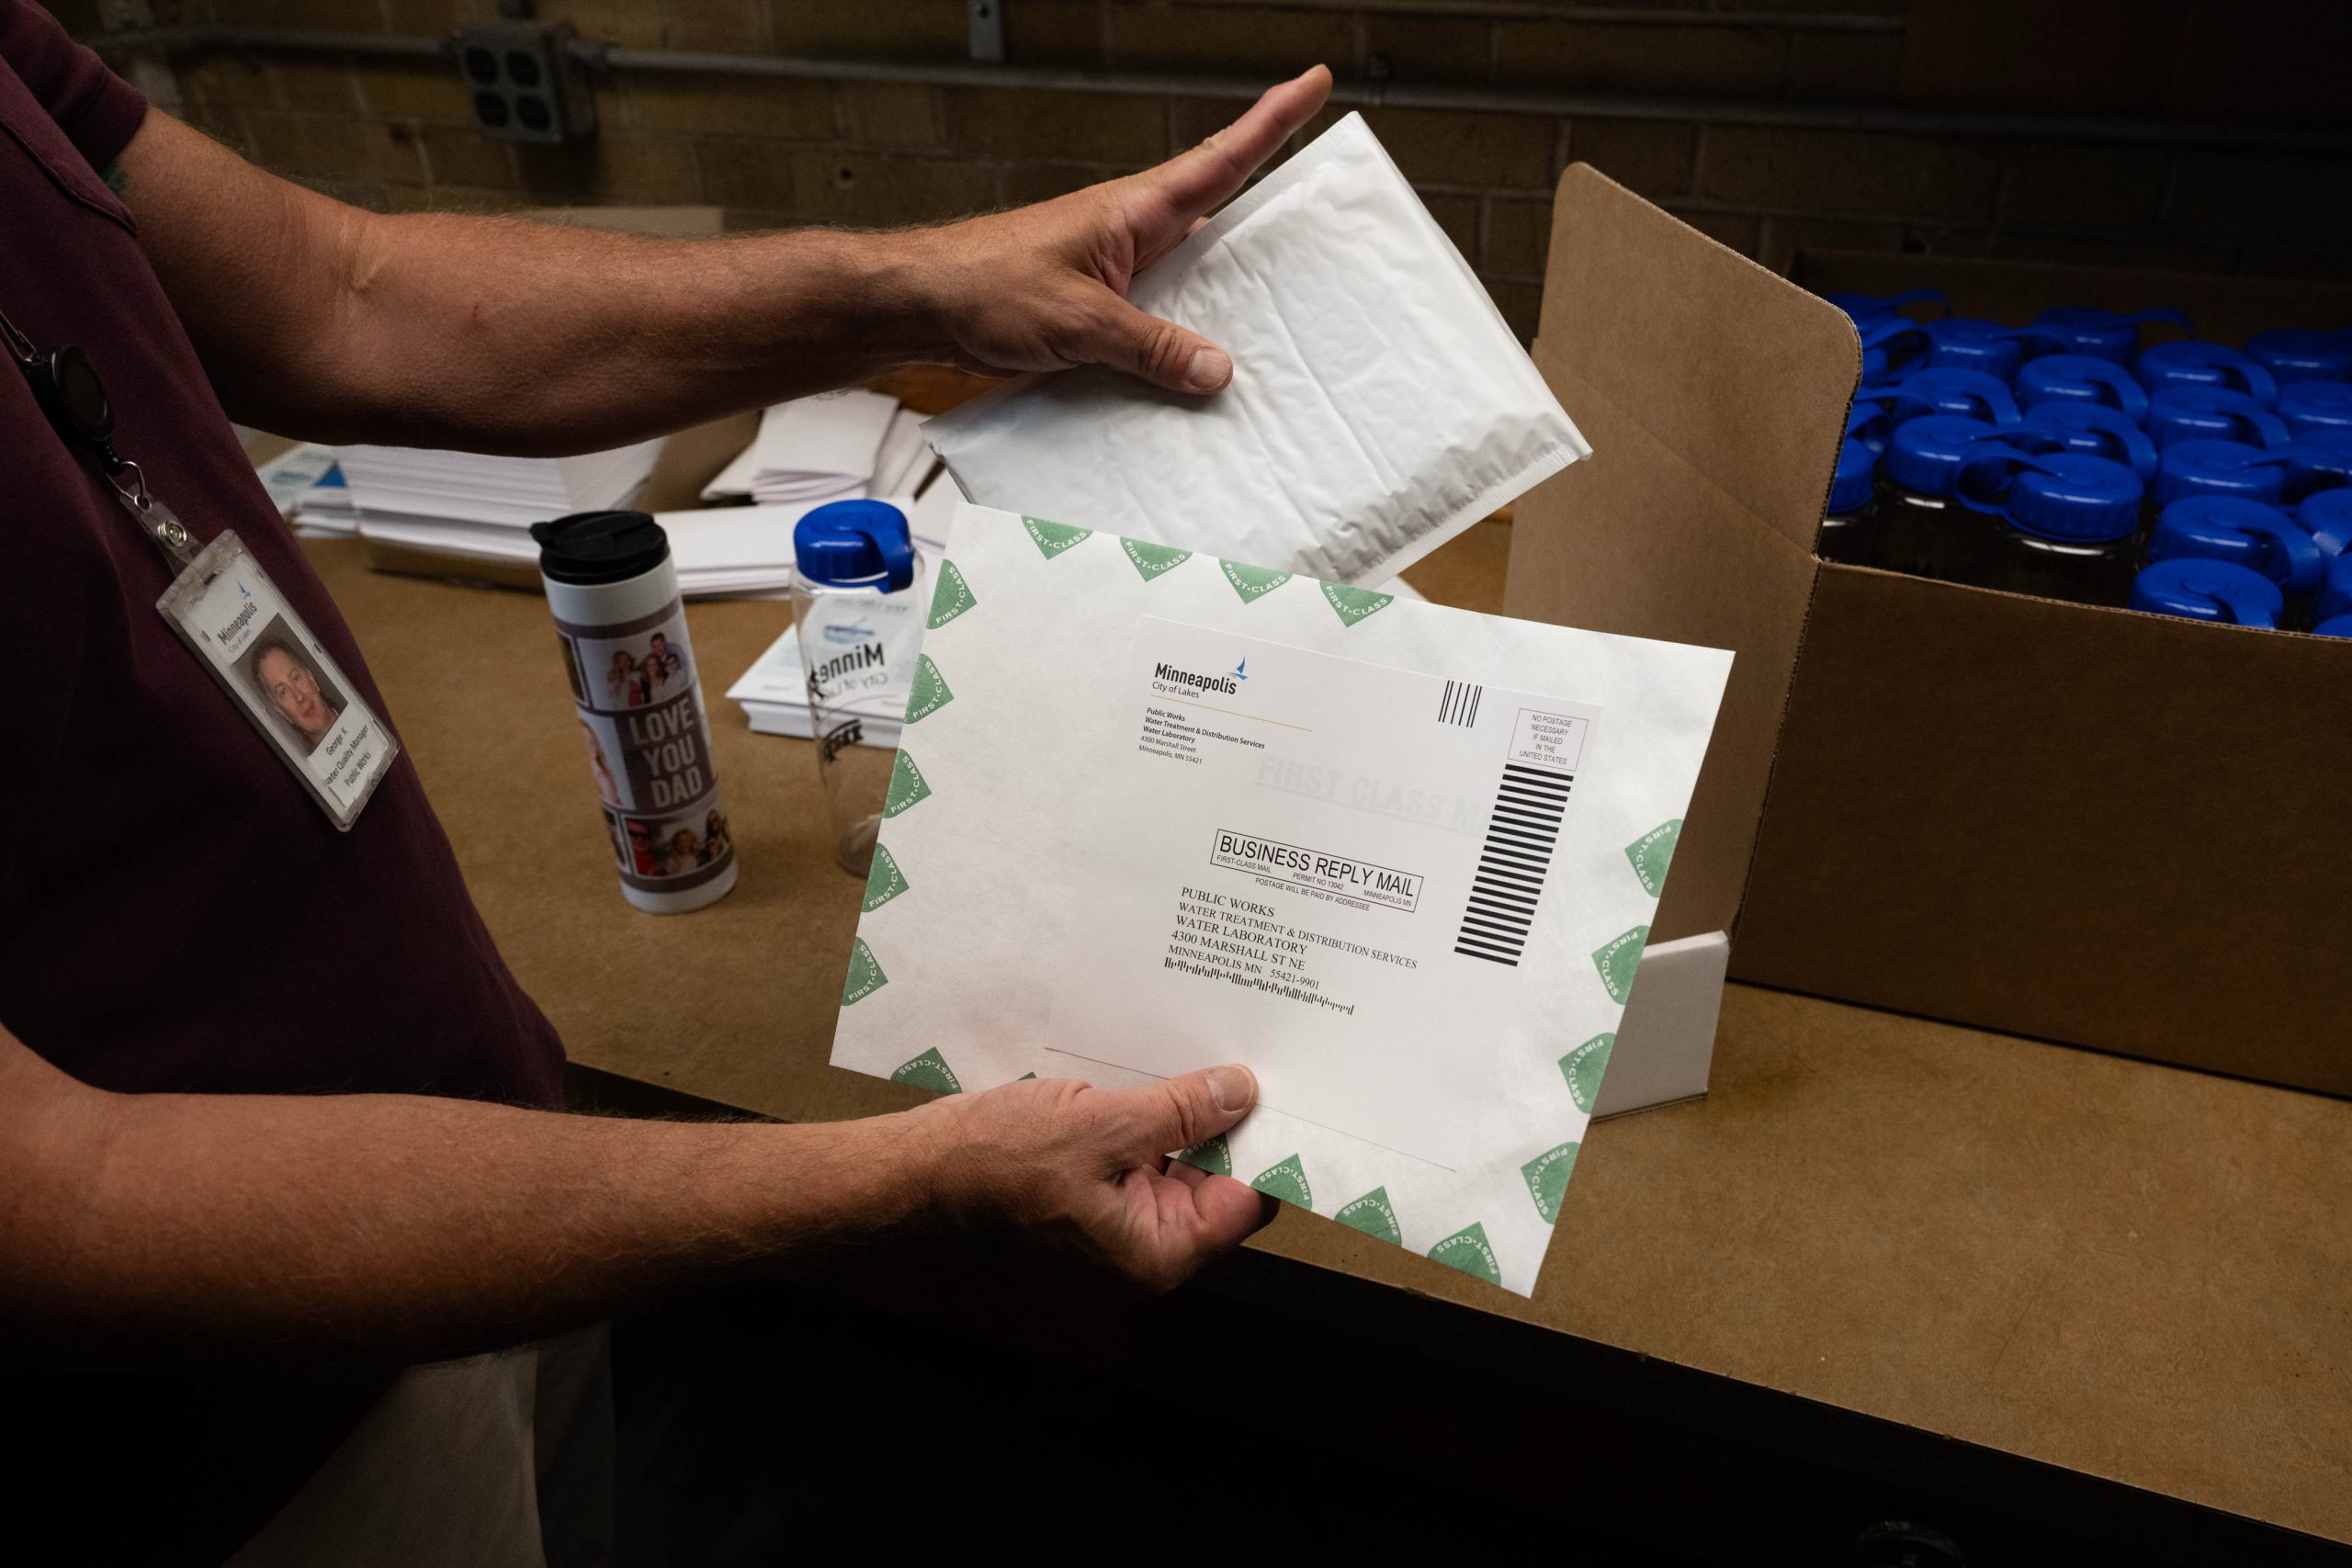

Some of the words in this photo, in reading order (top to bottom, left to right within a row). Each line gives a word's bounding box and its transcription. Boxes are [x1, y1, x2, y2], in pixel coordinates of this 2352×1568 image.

[218, 602, 258, 645] Minneapolis
[1152, 681, 1168, 693] City
[1178, 687, 1200, 698] Lakes
[1155, 662, 1238, 694] Minneapolis
[628, 696, 694, 745] LOVE
[1147, 707, 1166, 717] Public
[1167, 712, 1185, 722] Works
[1532, 724, 1568, 735] NECESSARY
[1543, 716, 1572, 727] POSTAGE
[326, 734, 343, 756] George
[336, 748, 354, 770] Quality
[349, 724, 368, 750] Manager
[1140, 736, 1155, 744] 4300
[1156, 739, 1179, 749] Marshall
[1180, 744, 1196, 753] Street
[1143, 726, 1160, 736] Water
[1161, 729, 1195, 744] Laboratory
[1145, 716, 1162, 727] Water
[1164, 720, 1195, 734] Treatment
[1202, 728, 1238, 743] Distribution
[1239, 738, 1265, 750] Services
[1540, 735, 1563, 744] MAILED
[1544, 745, 1556, 753] THE
[344, 767, 360, 787] Public
[356, 750, 371, 770] Works
[643, 735, 695, 777] YOU
[1138, 744, 1173, 759] Minneapolis,
[1174, 752, 1184, 761] MN
[1185, 754, 1203, 764] 55421
[1520, 750, 1542, 760] UNITED
[1544, 755, 1566, 764] STATES
[650, 766, 703, 808] DAD
[1216, 854, 1257, 871] FIRST-CLASS
[1257, 864, 1272, 874] MAIL
[1219, 835, 1311, 872] BUSINESS
[1315, 857, 1374, 886] REPLY
[1375, 872, 1414, 897] MAIL
[1255, 877, 1284, 890] POSTAGE
[1285, 885, 1300, 893] WILL
[1301, 887, 1309, 896] BE
[1310, 890, 1325, 900] PAID
[1334, 896, 1370, 911] ADDRESSEE
[1292, 872, 1316, 884] PERMIT
[1316, 878, 1327, 886] NO
[1328, 880, 1344, 890] 13042
[1181, 886, 1227, 906] PUBLIC
[1229, 897, 1275, 918] WORKS
[1363, 888, 1402, 906] MINNEAPOLIS
[1402, 898, 1412, 907] MN
[1170, 930, 1198, 944] 4300
[1199, 936, 1268, 962] MARSHALL
[1271, 953, 1286, 965] ST
[1288, 957, 1306, 971] NE
[1176, 915, 1219, 934] WATER
[1223, 925, 1308, 955] LABORATORY
[1179, 901, 1216, 919] WATER
[1219, 910, 1285, 934] TREATMENT
[1286, 927, 1295, 937] &
[1297, 930, 1369, 957] DISTRIBUTION
[1370, 949, 1418, 969] SERVICES
[1168, 944, 1241, 969] MINNEAPOLIS
[1244, 962, 1262, 974] MN
[1270, 969, 1319, 990] 55421-9901
